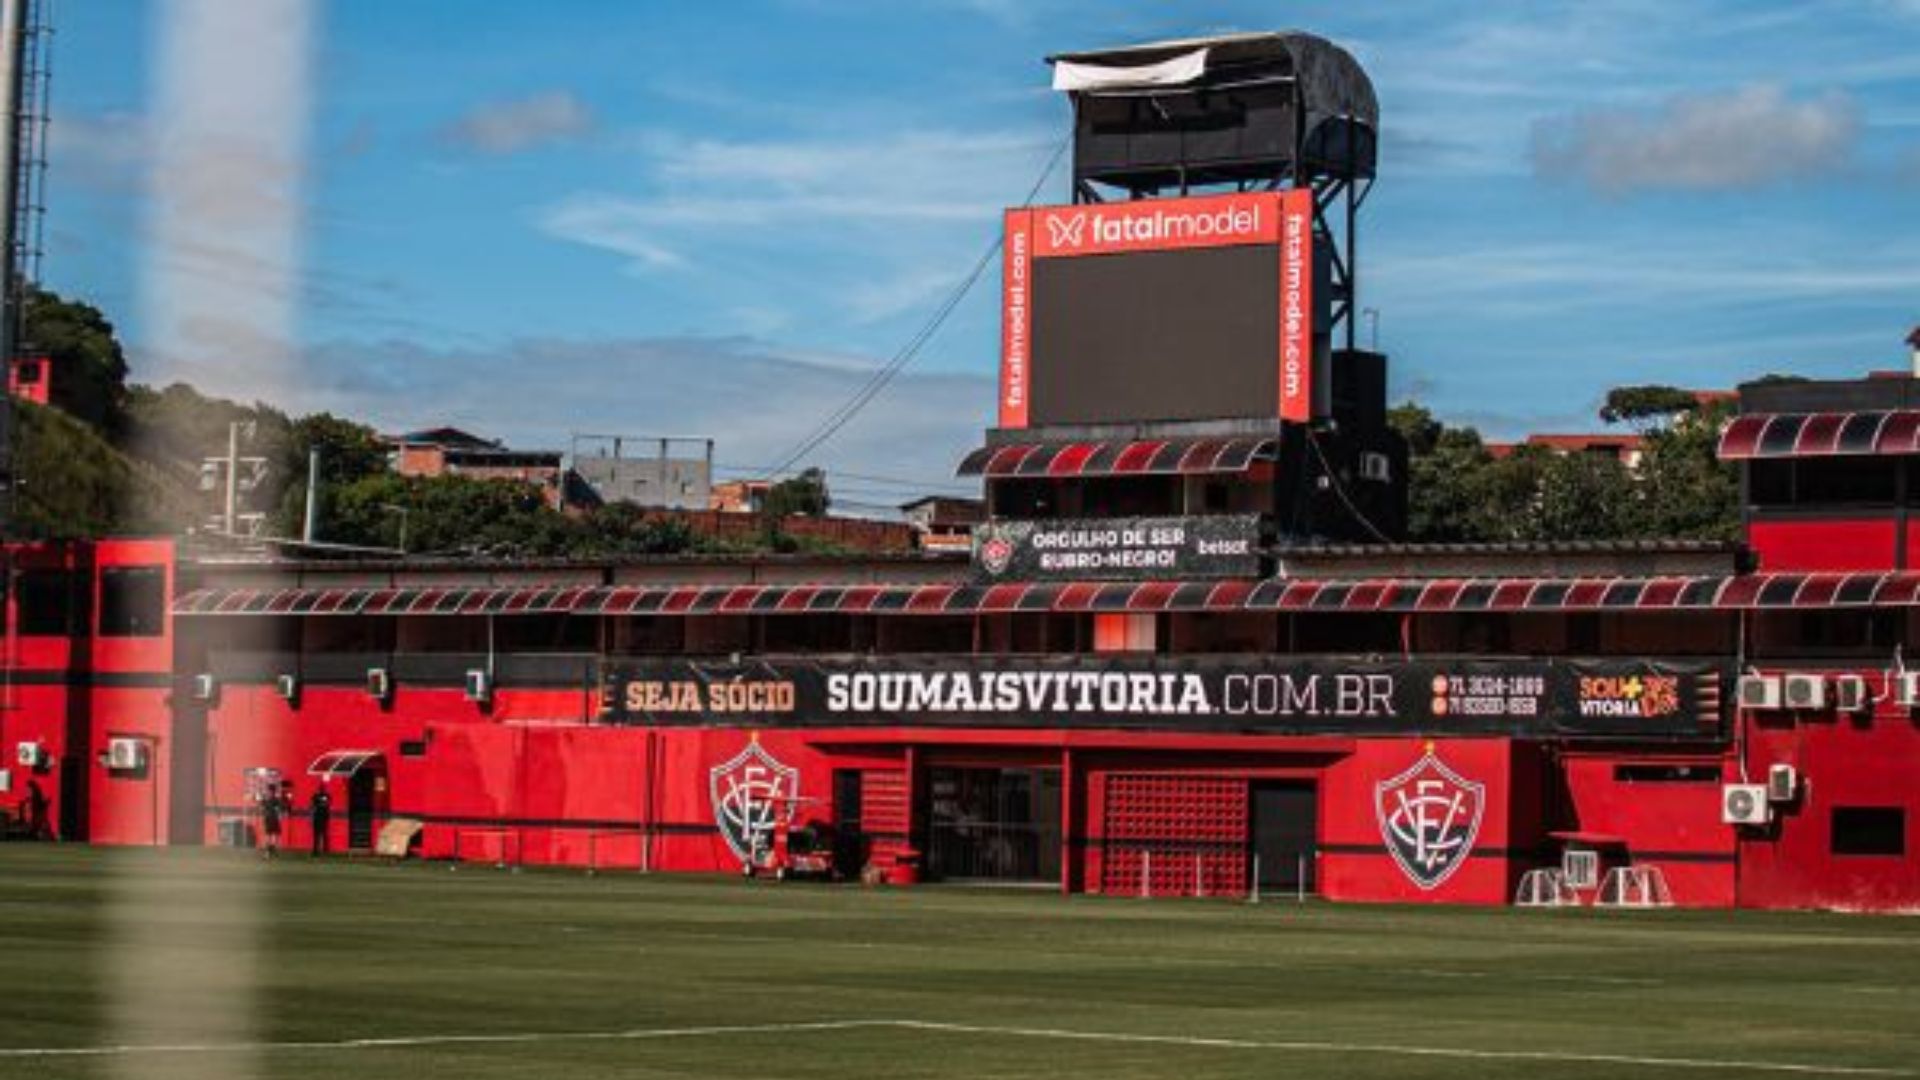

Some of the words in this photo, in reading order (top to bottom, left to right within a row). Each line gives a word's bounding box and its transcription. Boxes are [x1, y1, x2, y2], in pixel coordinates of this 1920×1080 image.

[1093, 204, 1260, 242] fatalmodel
[1007, 231, 1026, 408] fatalmodel.com
[1285, 213, 1304, 397] fatalmodel.com
[1033, 530, 1118, 549] ORGULHO
[1122, 529, 1146, 547] DE
[1151, 527, 1185, 546] SER
[1040, 549, 1176, 569] RUBRO-NEGRO!
[626, 680, 702, 712] SEJA
[708, 675, 795, 712] SÓCIO
[828, 671, 1396, 716] SOUMAISVITORIA.COM.BR
